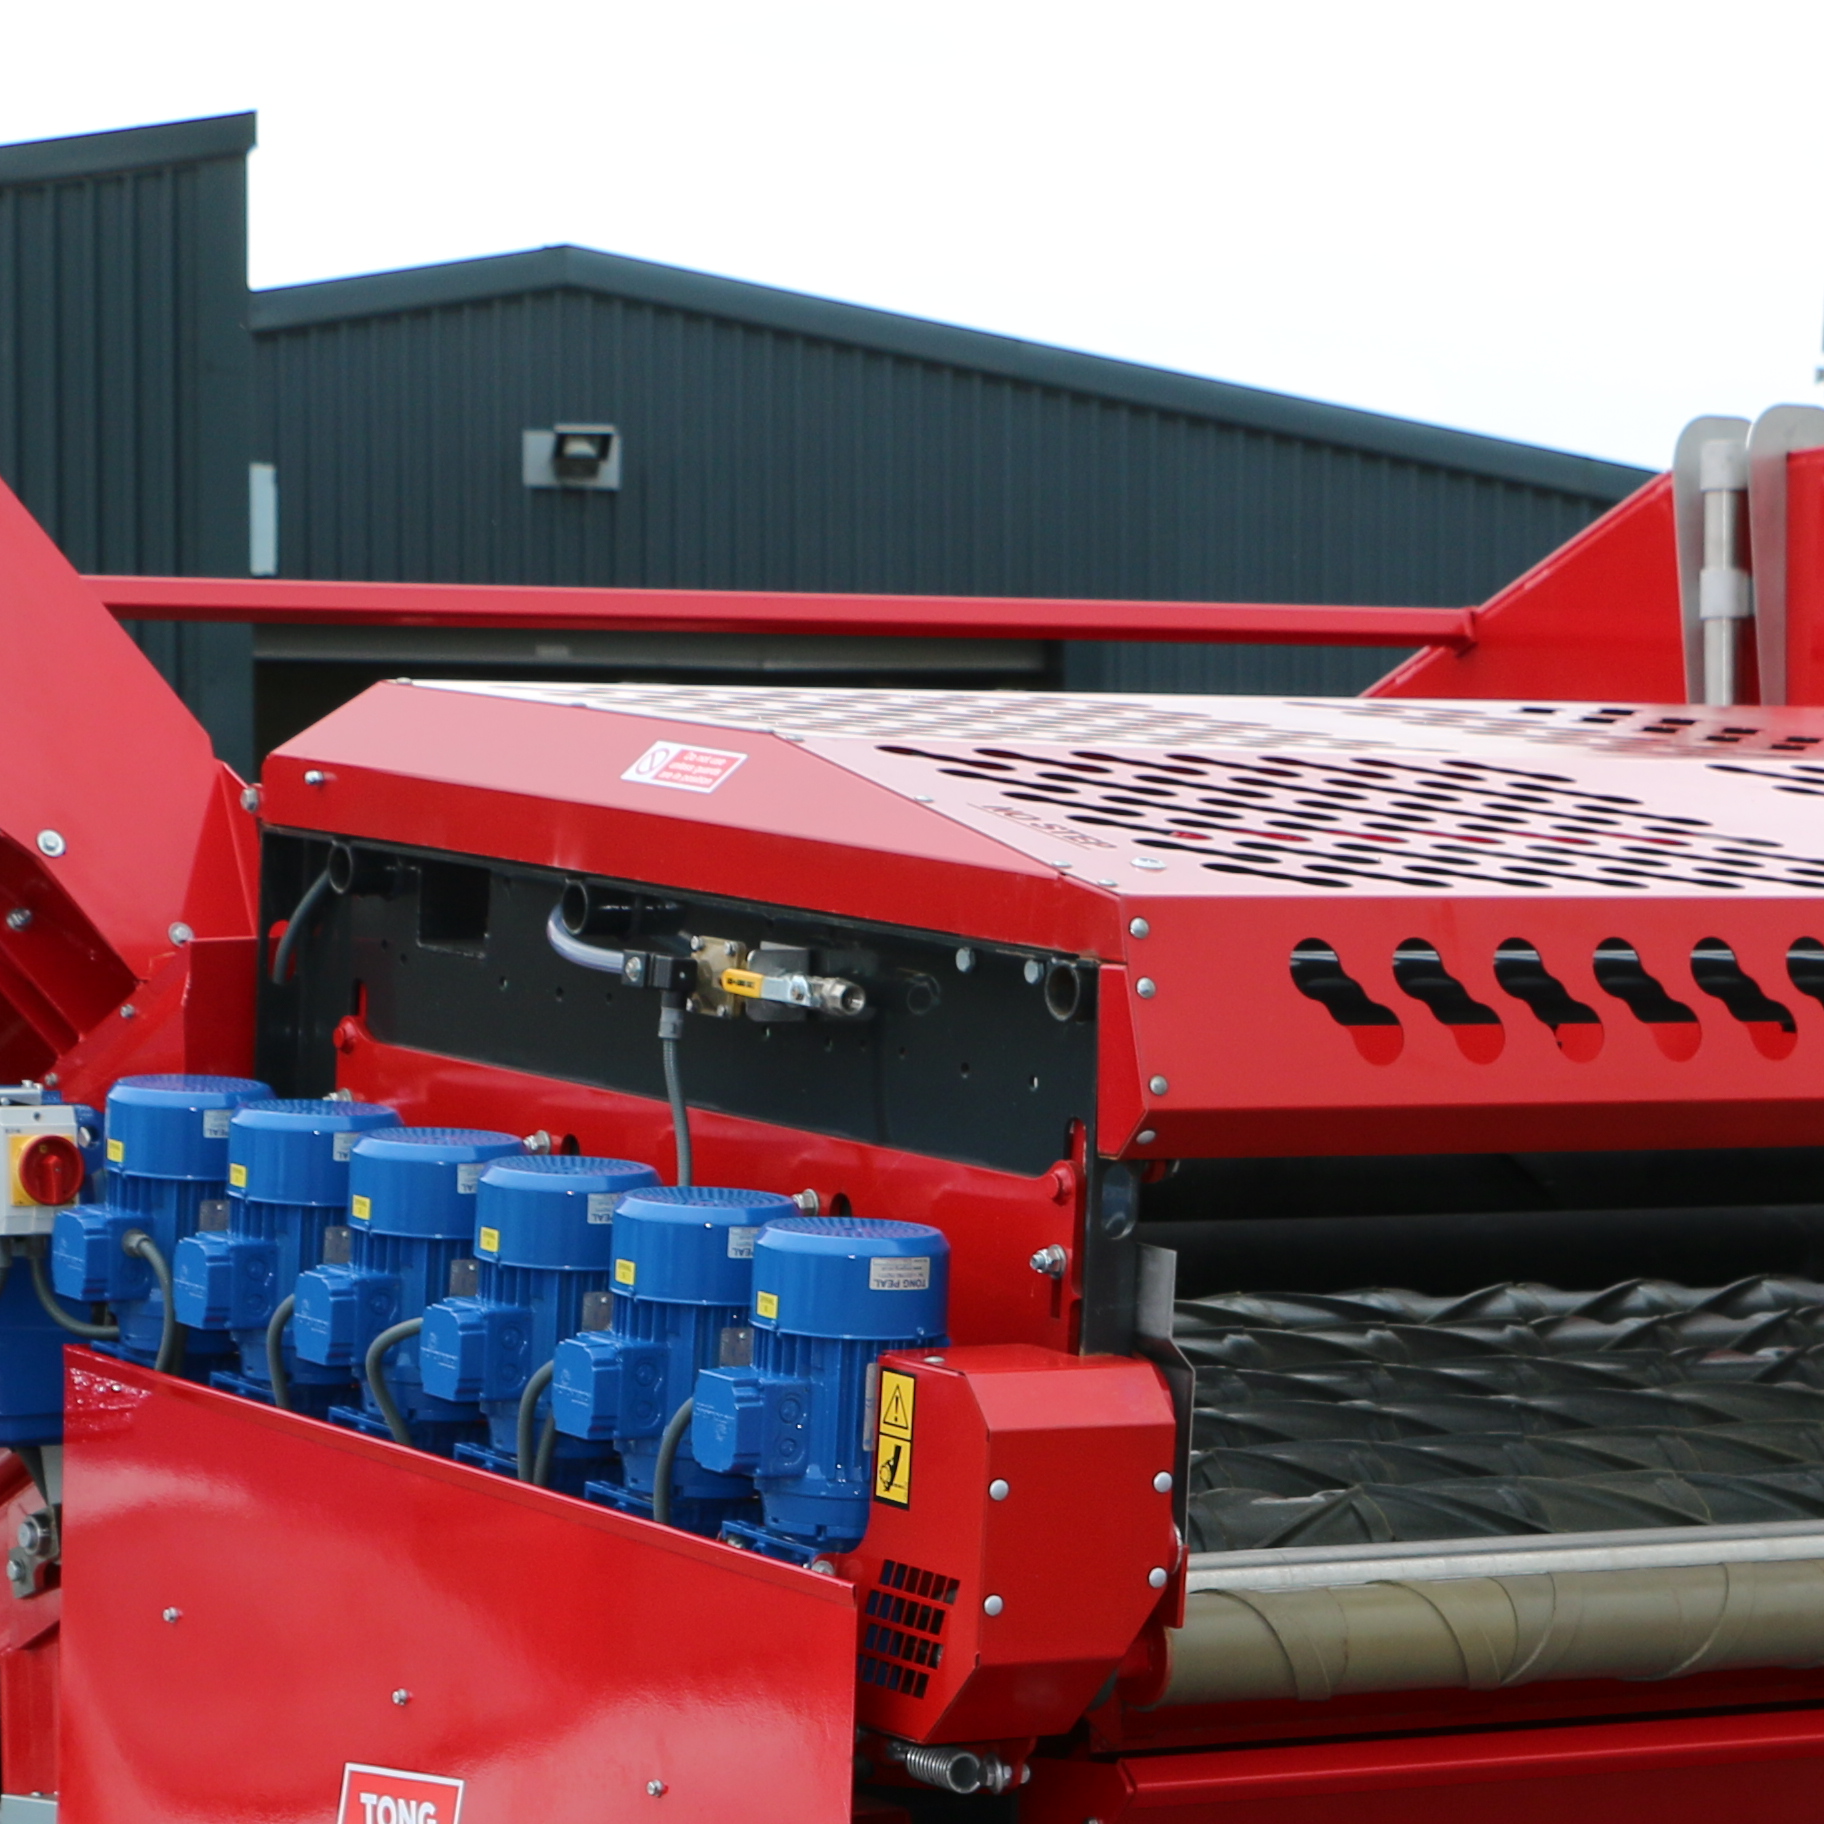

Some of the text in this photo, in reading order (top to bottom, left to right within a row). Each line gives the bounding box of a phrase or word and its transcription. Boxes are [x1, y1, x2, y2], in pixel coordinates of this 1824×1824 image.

[1029, 823, 1118, 849] STEP
[873, 1278, 926, 1288] TONG PEAL
